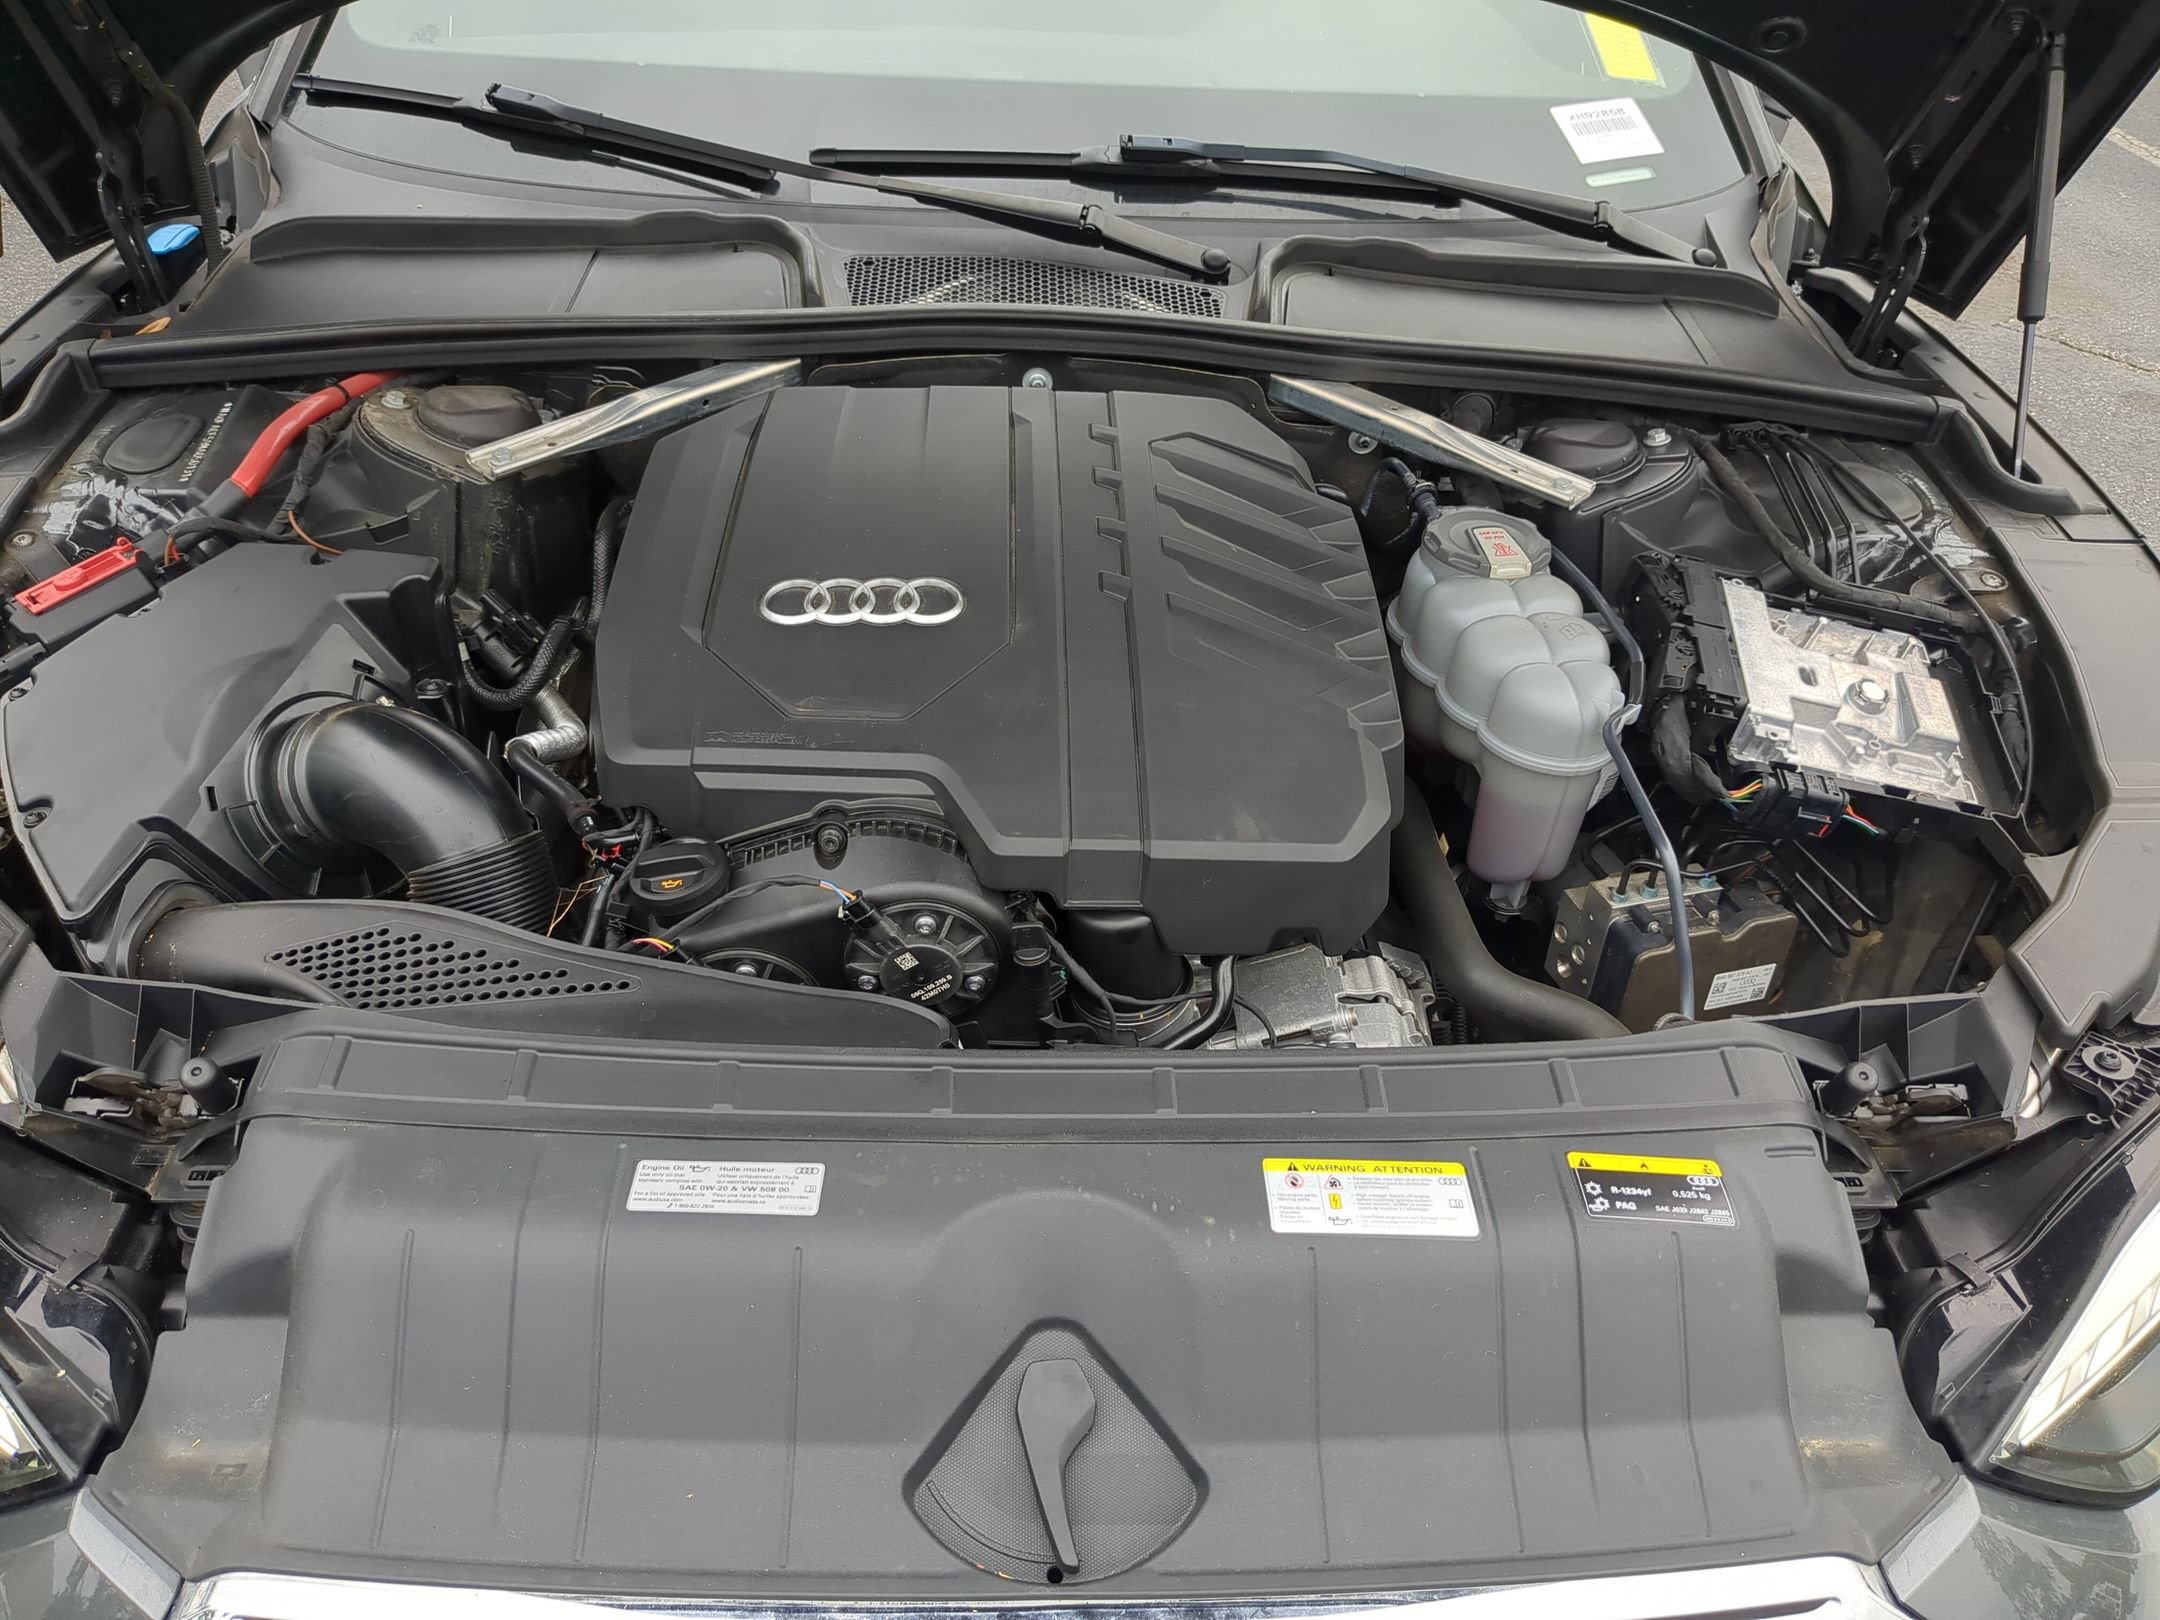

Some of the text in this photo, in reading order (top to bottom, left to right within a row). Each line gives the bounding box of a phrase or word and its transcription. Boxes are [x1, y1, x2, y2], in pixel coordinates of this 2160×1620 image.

[1303, 1163, 1443, 1174] WARNING ATTENTION
[699, 1184, 728, 1192] 0W-20
[1610, 1186, 1652, 1197] R-1234yf
[1699, 1190, 1711, 1201] kg
[1615, 1201, 1637, 1210] PAG
